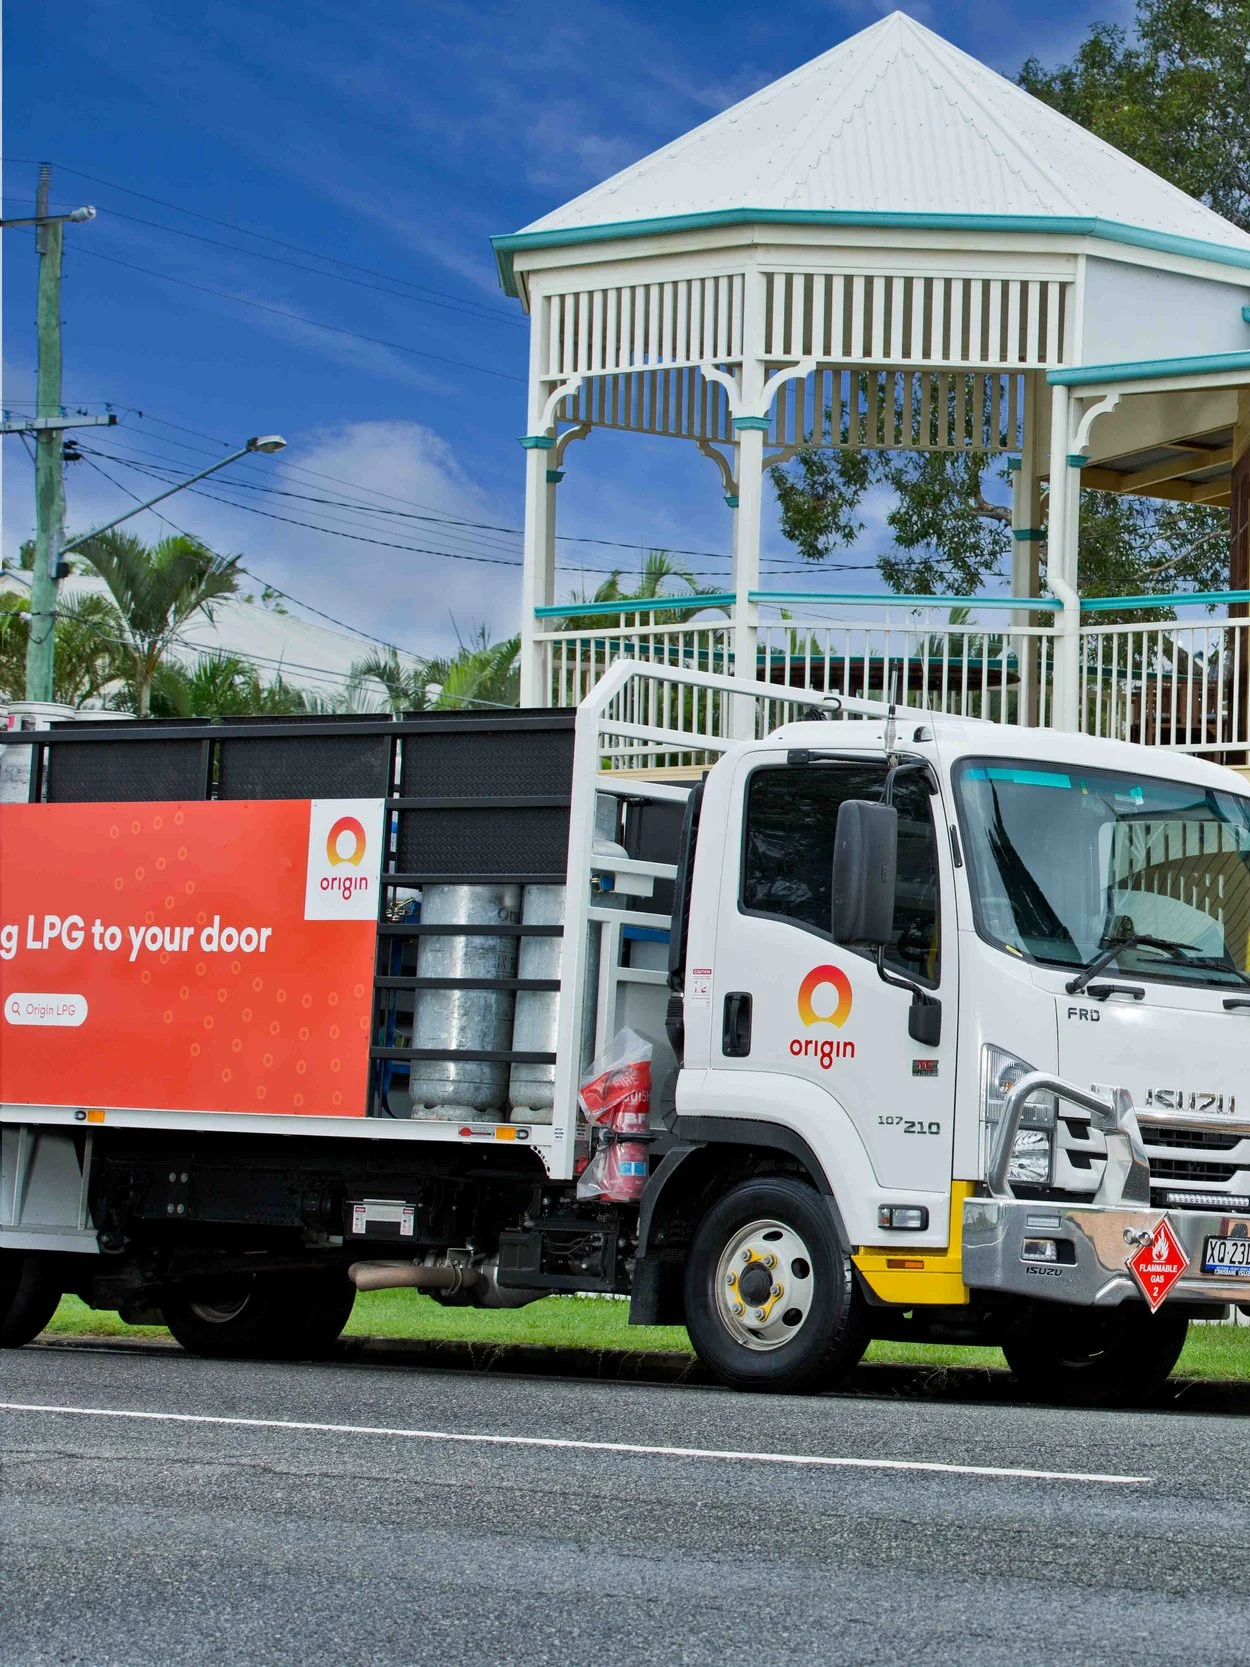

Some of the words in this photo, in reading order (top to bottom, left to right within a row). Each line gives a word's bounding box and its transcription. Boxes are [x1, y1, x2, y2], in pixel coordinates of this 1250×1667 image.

[320, 876, 368, 900] origin
[26, 914, 85, 951] LPG
[91, 918, 122, 951] to
[128, 924, 194, 962] your
[200, 915, 272, 953] door
[26, 1003, 54, 1018] Origin
[56, 1003, 76, 1016] LPG
[1068, 1007, 1100, 1022] FRD
[789, 1039, 856, 1070] origin
[1145, 1088, 1236, 1115] ISUZU
[878, 1116, 903, 1125] 107
[904, 1121, 941, 1135] 210
[1026, 1267, 1063, 1277] ISUZU
[1140, 1263, 1178, 1273] FLAMMABLE
[1151, 1275, 1165, 1283] GAS
[1153, 1287, 1159, 1297] 2
